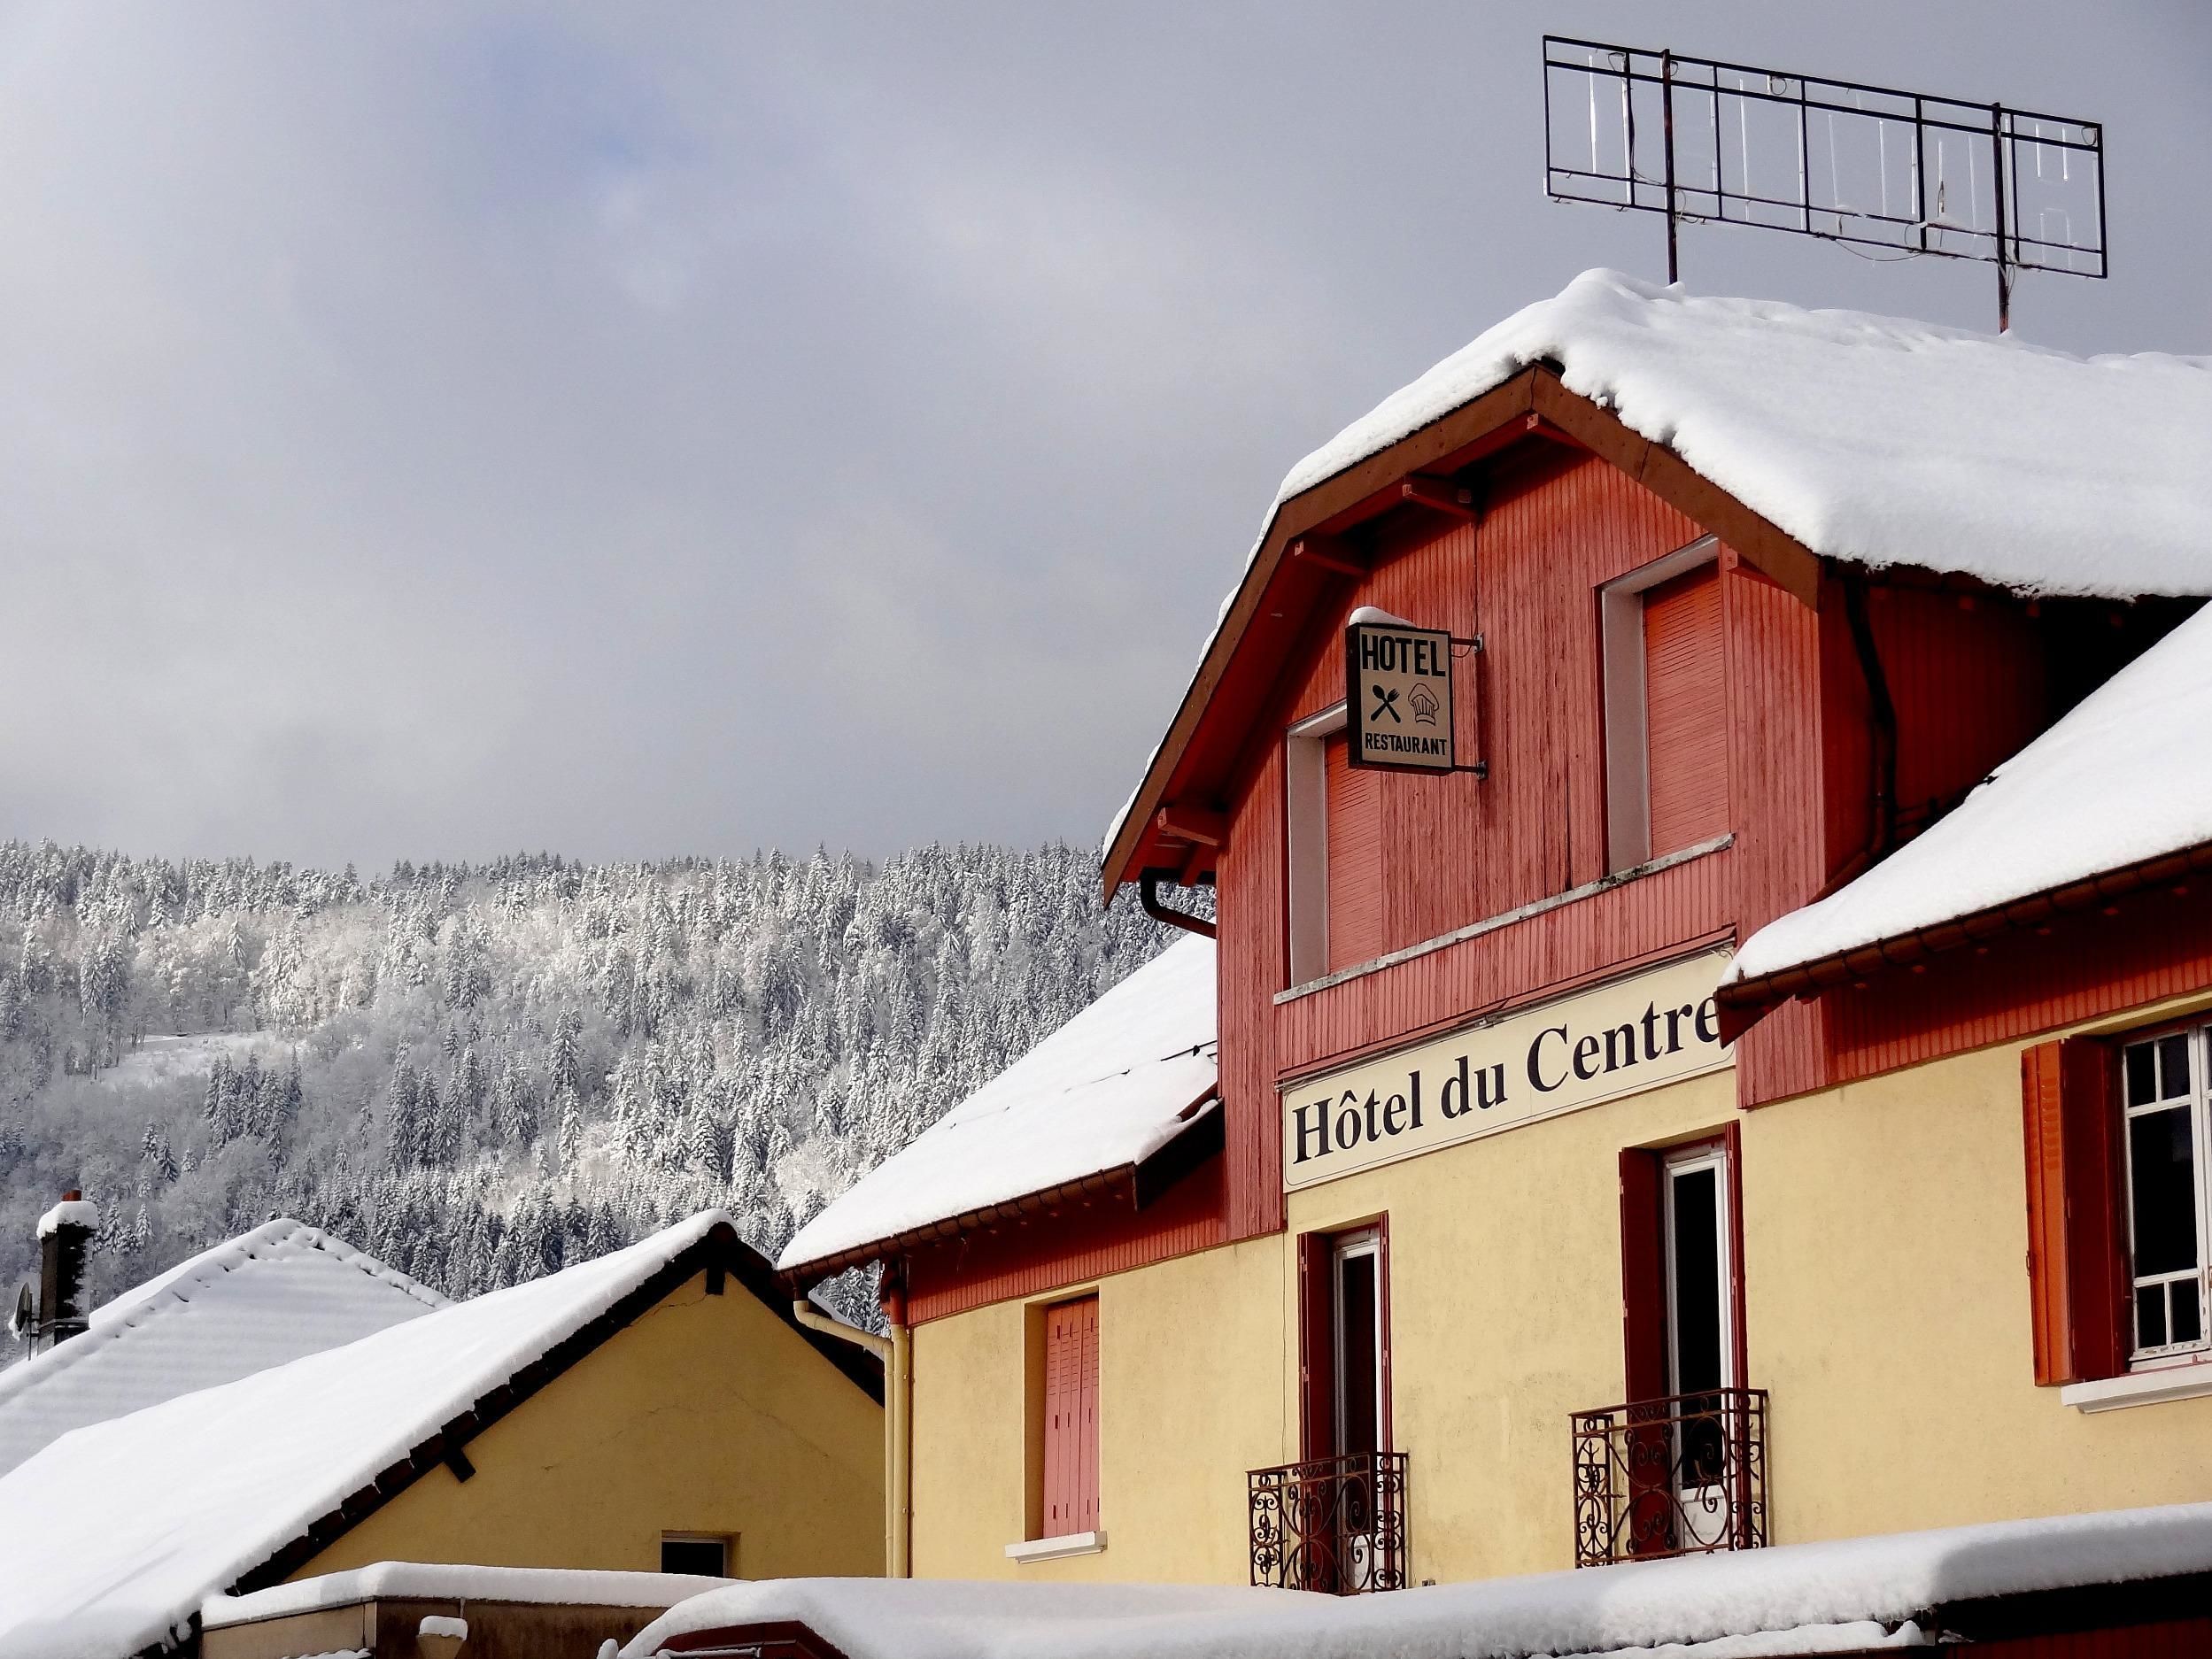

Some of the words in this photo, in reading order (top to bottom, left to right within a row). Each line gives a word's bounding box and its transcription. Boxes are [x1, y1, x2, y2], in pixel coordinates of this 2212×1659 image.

[1361, 634, 1446, 677] HOTEL
[1365, 732, 1447, 756] RESTAURANT
[1292, 1069, 1423, 1165] Hôtel
[1441, 1055, 1507, 1120] du
[1527, 996, 1720, 1092] Centre
